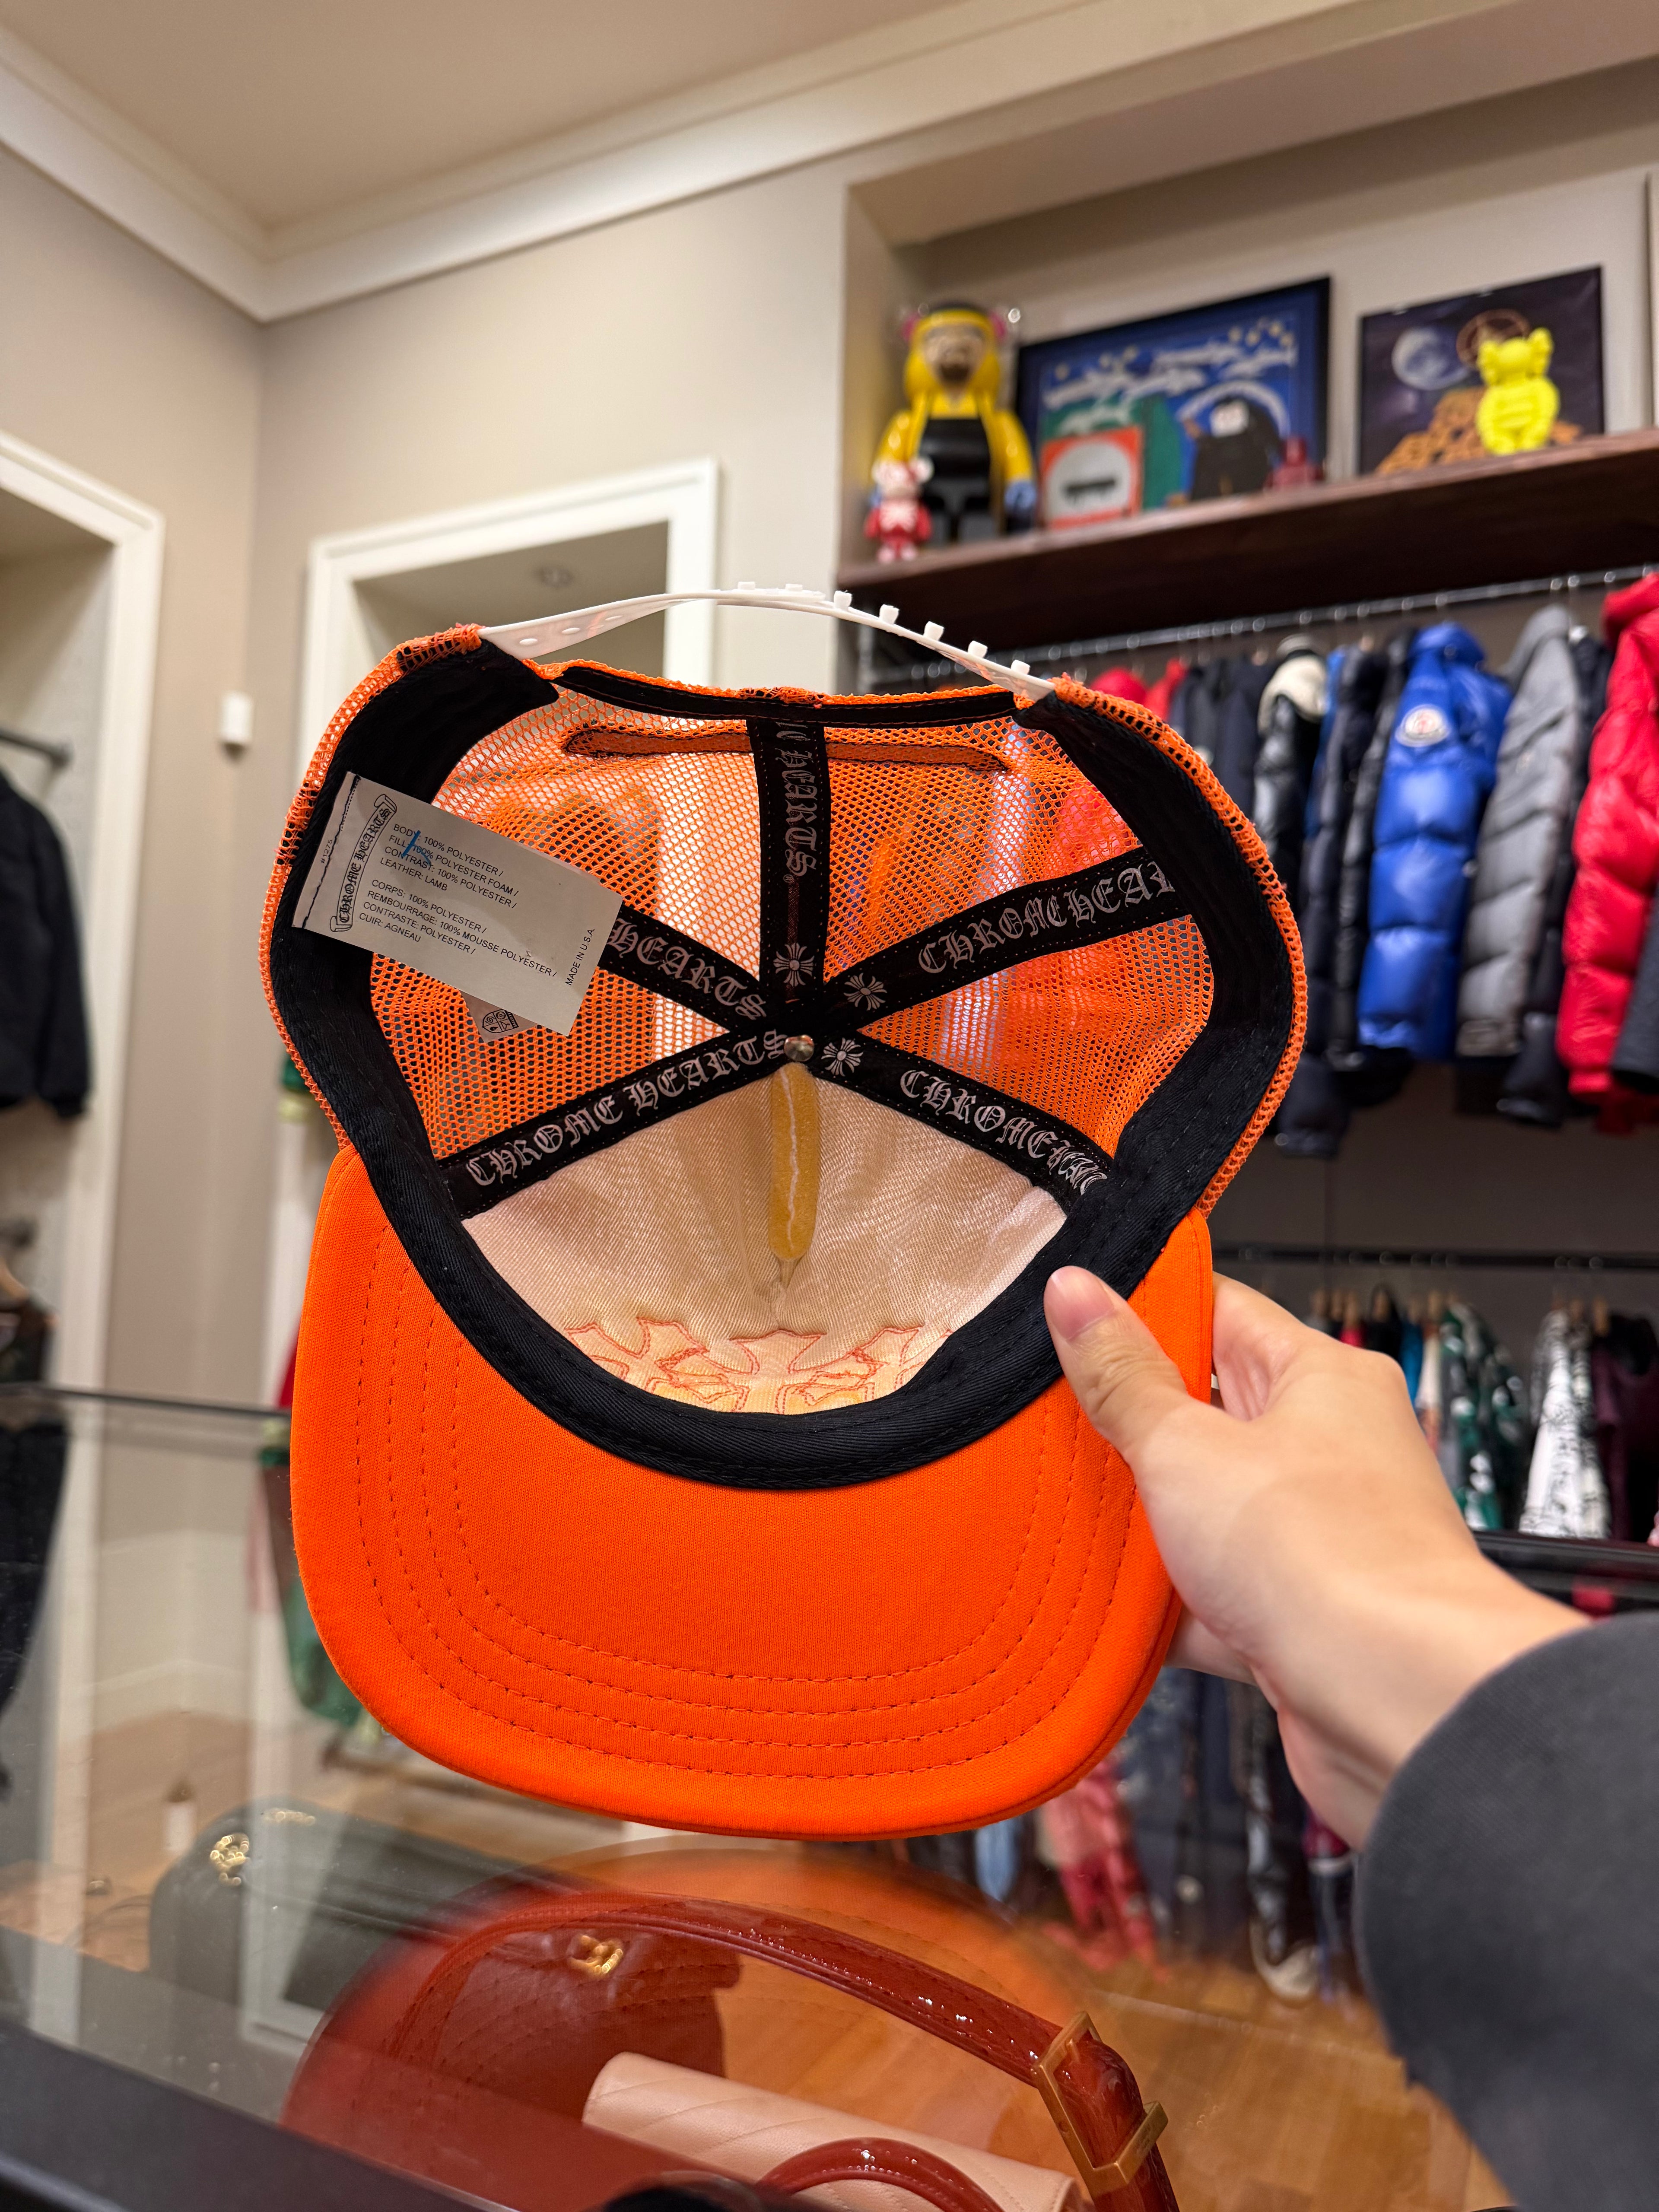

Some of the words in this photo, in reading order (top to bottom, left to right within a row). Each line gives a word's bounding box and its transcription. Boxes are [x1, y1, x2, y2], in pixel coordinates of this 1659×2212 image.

[321, 840, 332, 863] #1275
[339, 862, 362, 923] CHROME
[354, 807, 392, 863] HEARTS
[380, 858, 424, 880] LEATHER:
[424, 875, 448, 891] LAMB
[385, 846, 435, 873] CONTRAST:
[438, 868, 458, 883] 100%
[460, 879, 512, 907] POLYESTER
[389, 835, 410, 848] FILL
[413, 845, 433, 859] 100%
[435, 855, 486, 883] POLYESTER
[487, 878, 513, 895] FOAM
[424, 836, 445, 851] 100%
[447, 846, 498, 875] POLYESTER
[359, 912, 383, 928] CUIR:
[384, 922, 421, 942] AGNEAU
[363, 902, 419, 929] CONTRASTE:
[420, 925, 470, 953] POLYESTER
[367, 890, 438, 925] REMBOURRAGE:
[440, 921, 461, 936] 100%
[462, 931, 499, 953] MOUSSE
[500, 948, 552, 976] POLYESTER
[372, 879, 405, 898] CORPS:
[408, 893, 429, 908] 100%
[430, 904, 482, 932] POLYESTER
[918, 895, 1067, 973] CHROME
[565, 961, 581, 985] MADE
[575, 951, 585, 960] IN
[606, 918, 767, 1020] HEARTS
[466, 1096, 624, 1186] CHROME
[623, 1029, 788, 1117] HEARTS
[900, 1069, 1058, 1159] CHROME
